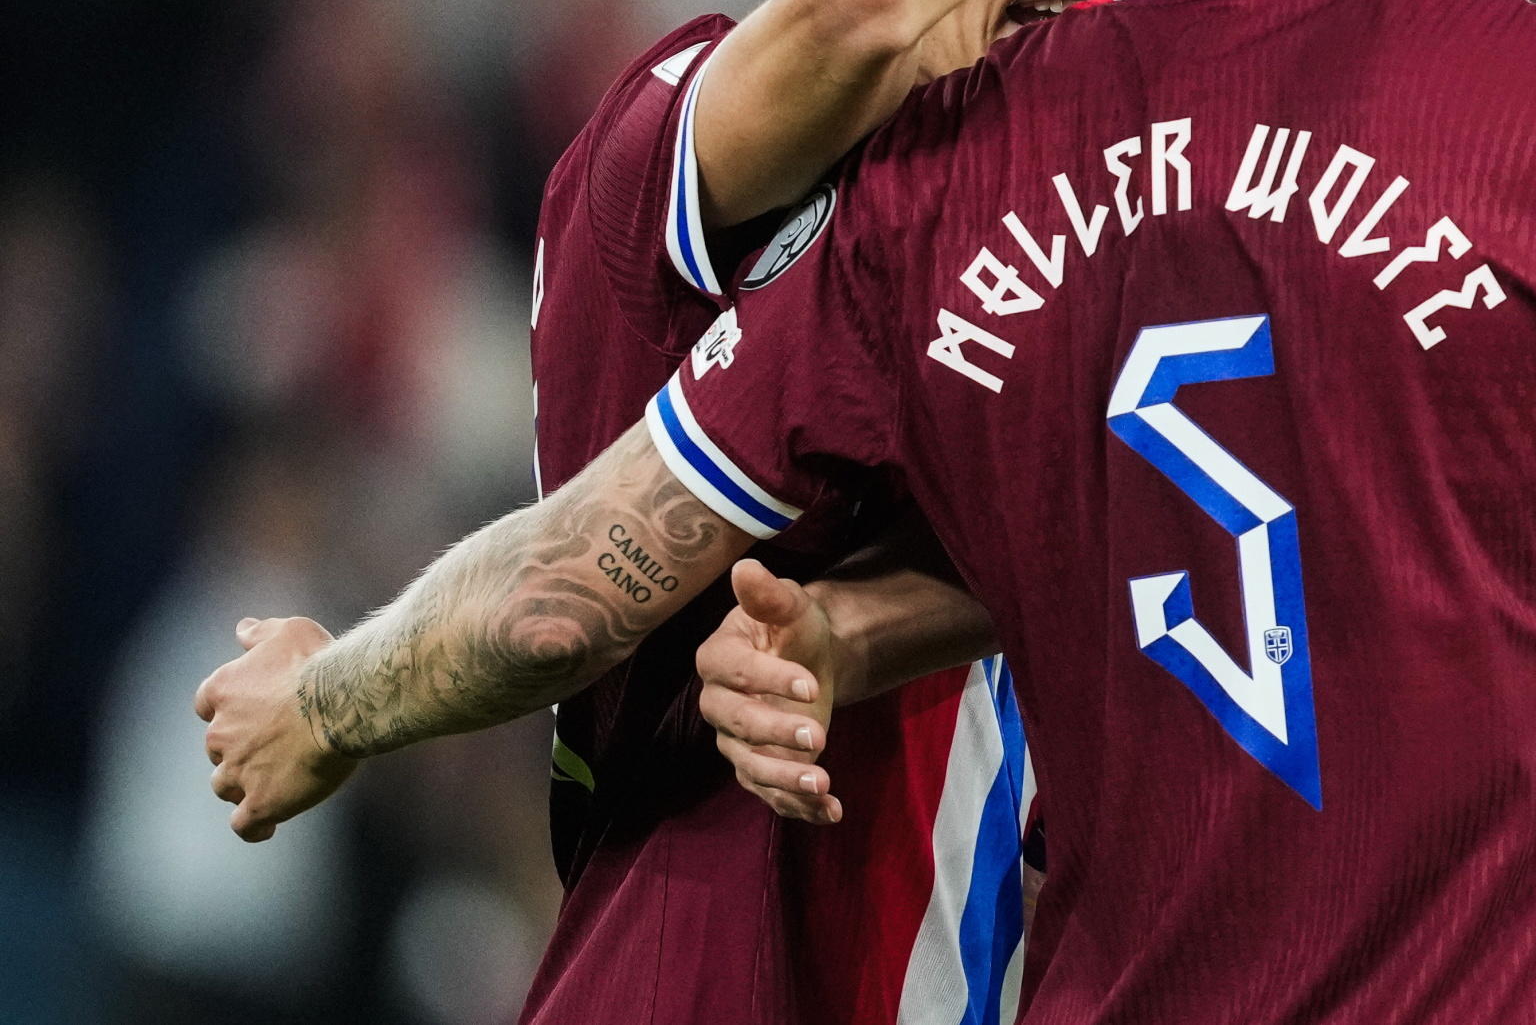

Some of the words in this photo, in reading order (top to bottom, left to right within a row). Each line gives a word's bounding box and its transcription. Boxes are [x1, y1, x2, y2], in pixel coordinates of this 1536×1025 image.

[927, 116, 1193, 393] MØLLER
[1224, 123, 1507, 351] WOLFE
[597, 552, 652, 604] CANO
[608, 524, 680, 593] CAMILO
[1106, 313, 1323, 812] 5
